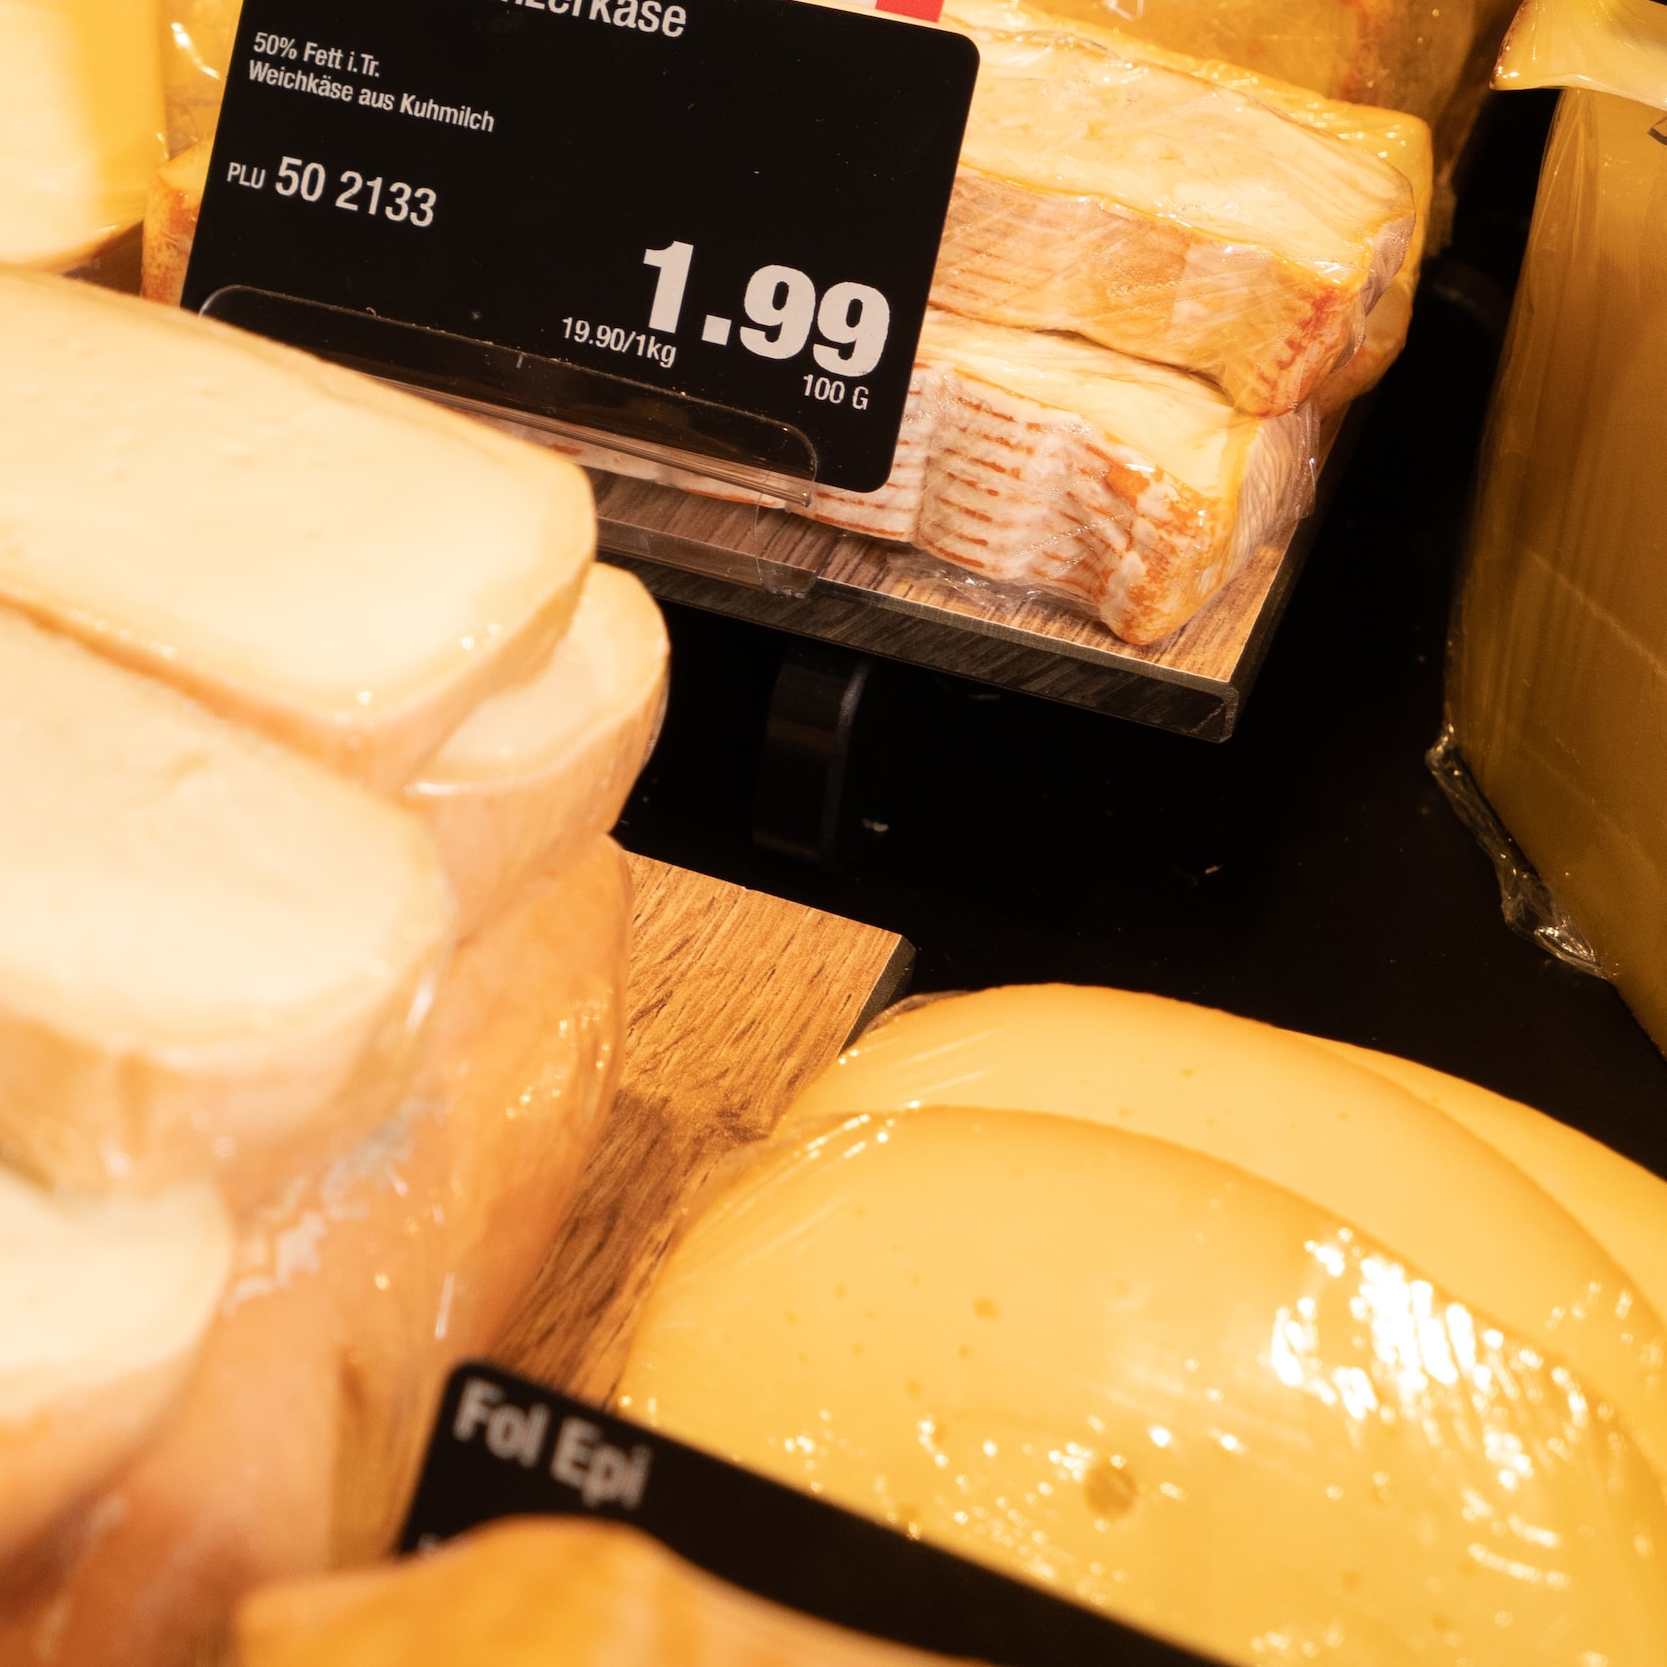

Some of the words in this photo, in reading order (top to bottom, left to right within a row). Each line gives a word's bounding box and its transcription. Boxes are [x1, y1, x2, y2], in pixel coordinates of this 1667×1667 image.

[253, 31, 297, 60] 50%
[302, 41, 344, 70] Fett
[347, 51, 380, 77] i.Tr.
[248, 59, 354, 102] Weichkäse
[358, 85, 395, 111] aus
[399, 92, 496, 133] Kuhmilch
[226, 161, 266, 190] PLU
[274, 155, 327, 203] 50
[335, 169, 439, 228] 2133
[562, 316, 677, 369] 19.90/1kg
[642, 240, 891, 378] 1.99
[802, 373, 845, 404] 100
[851, 386, 869, 411] G
[453, 1377, 550, 1469] Fol
[550, 1416, 653, 1511] Epi
